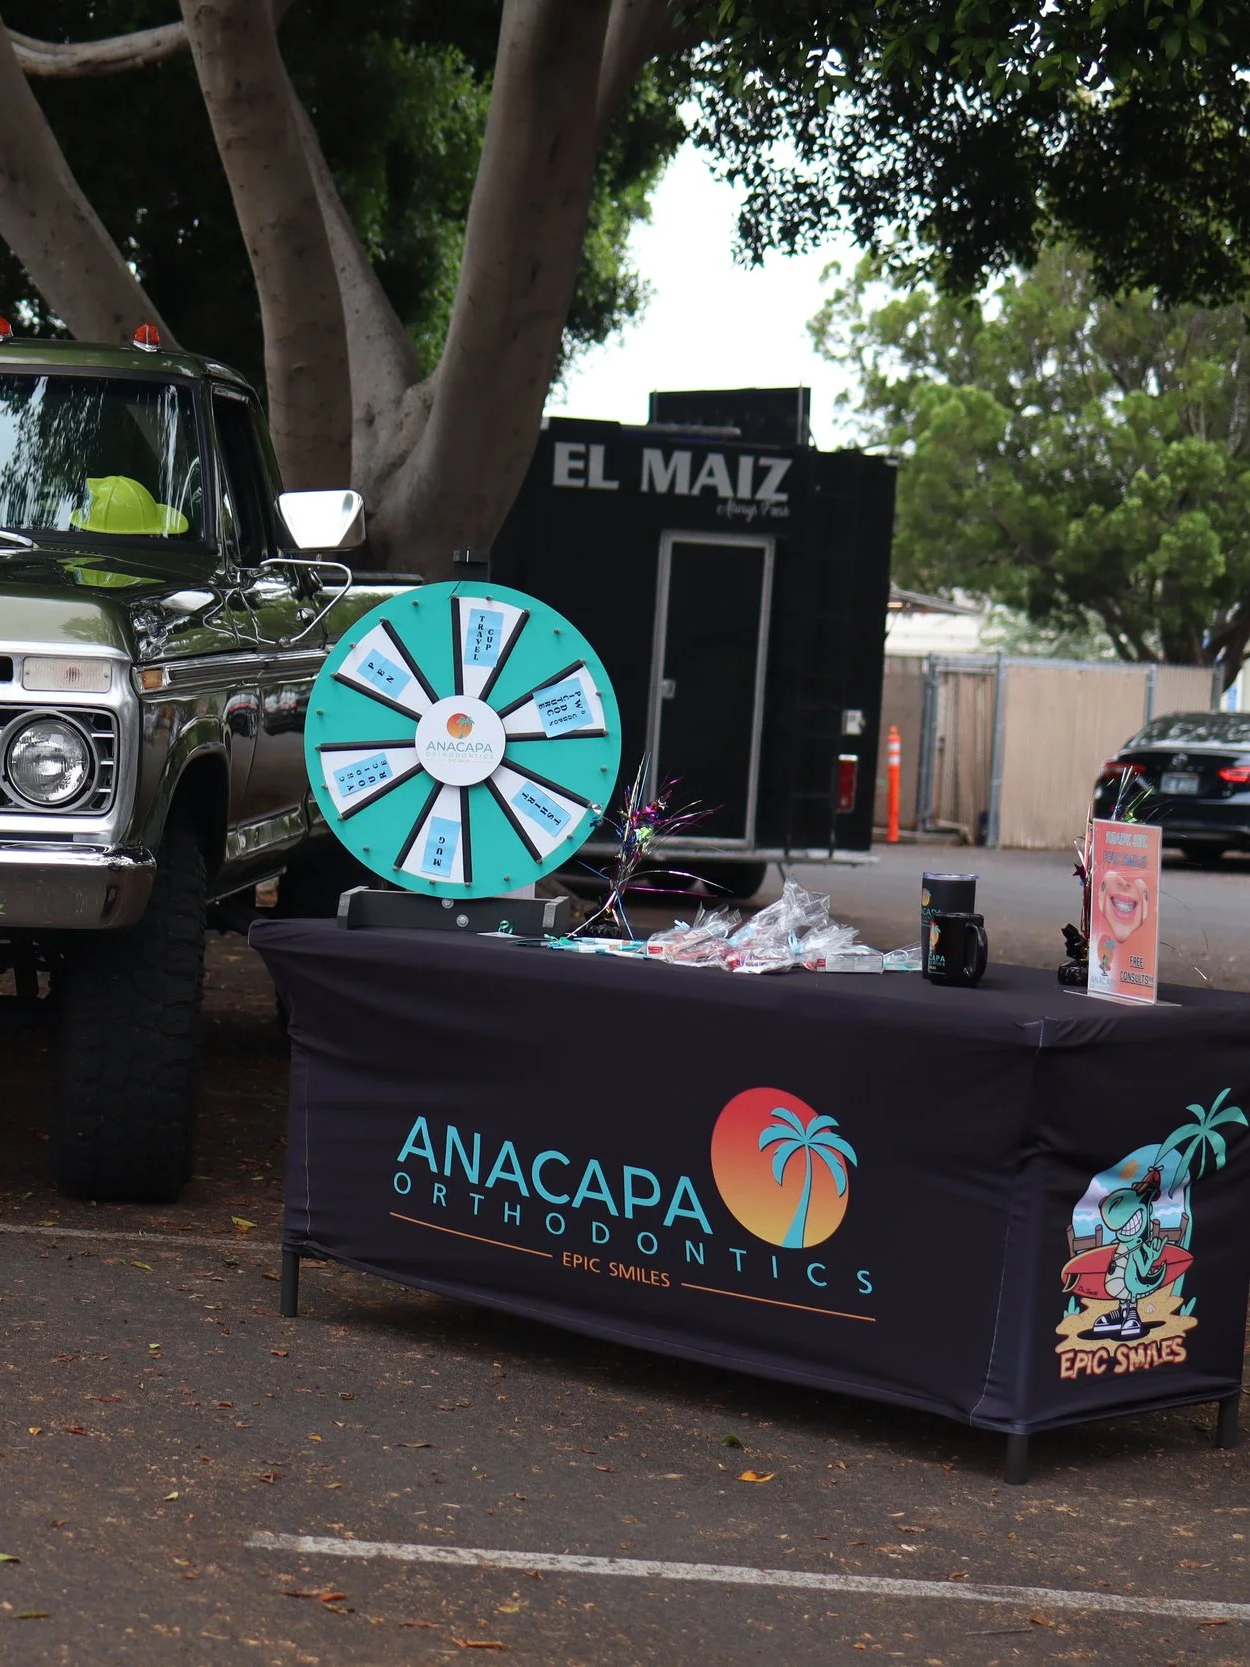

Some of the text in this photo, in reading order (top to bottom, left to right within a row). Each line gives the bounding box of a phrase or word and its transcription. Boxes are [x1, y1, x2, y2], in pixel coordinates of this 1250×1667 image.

[552, 441, 793, 501] EL MAIZ
[473, 615, 486, 661] TRAVEL
[485, 629, 495, 651] CUP
[367, 661, 395, 684] PEN
[426, 740, 493, 753] ANACAPA
[338, 759, 388, 782] CHOICE
[346, 771, 387, 792] YOUR
[432, 836, 446, 867] GUM
[1129, 955, 1145, 969] FREE
[396, 1115, 714, 1235] ANACAPA
[393, 1171, 874, 1295] ORTHODONTICS
[562, 1251, 671, 1288] EPIC SMILES
[1059, 1336, 1187, 1379] EPIC SMILES
